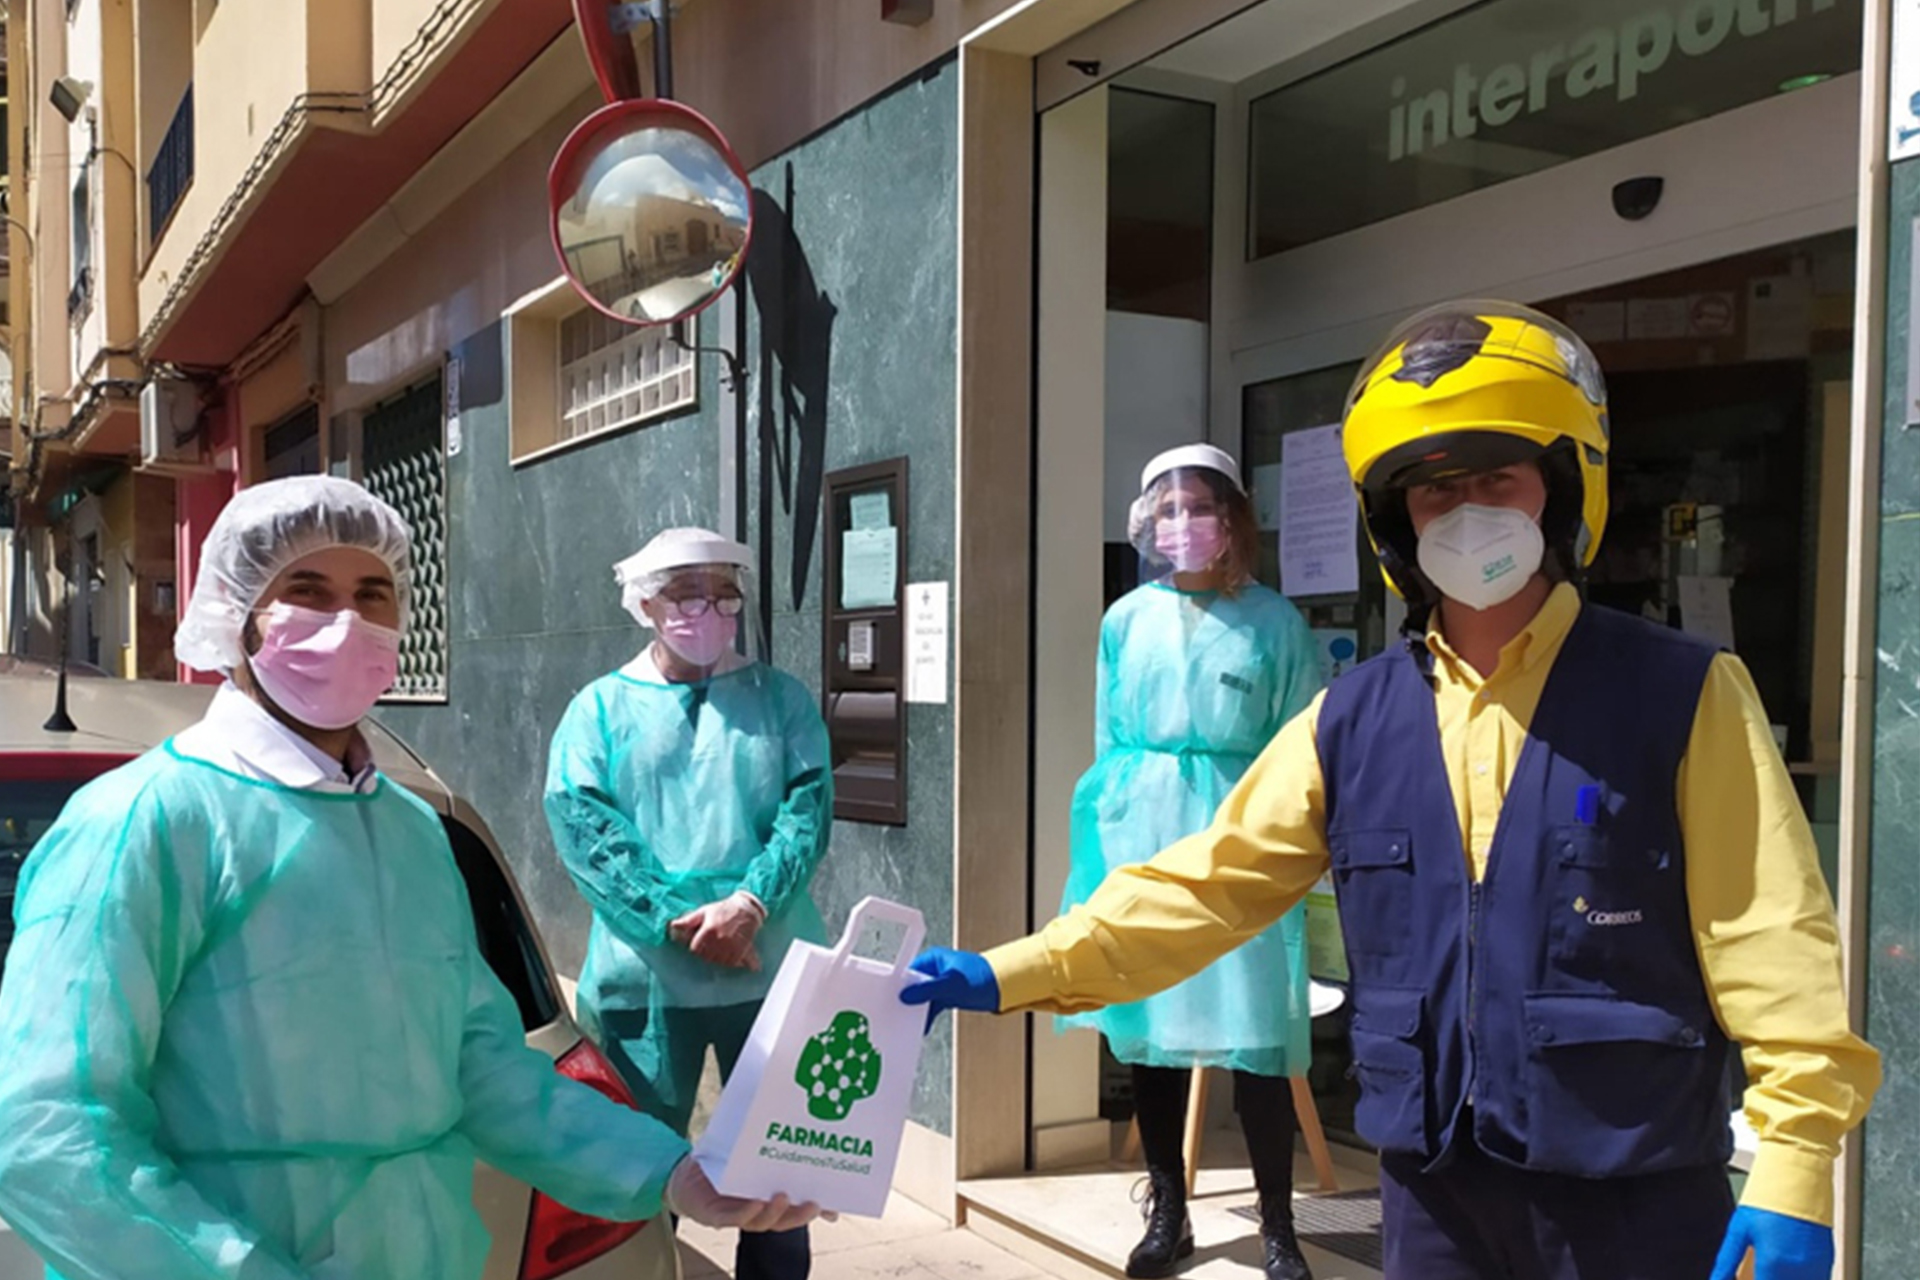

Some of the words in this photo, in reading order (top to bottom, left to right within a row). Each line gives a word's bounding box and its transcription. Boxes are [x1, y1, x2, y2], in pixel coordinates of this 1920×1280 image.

[1389, 0, 1836, 161] interapo
[767, 1123, 872, 1157] FARMACIA
[759, 1147, 870, 1174] #CuidamosTuSalud
